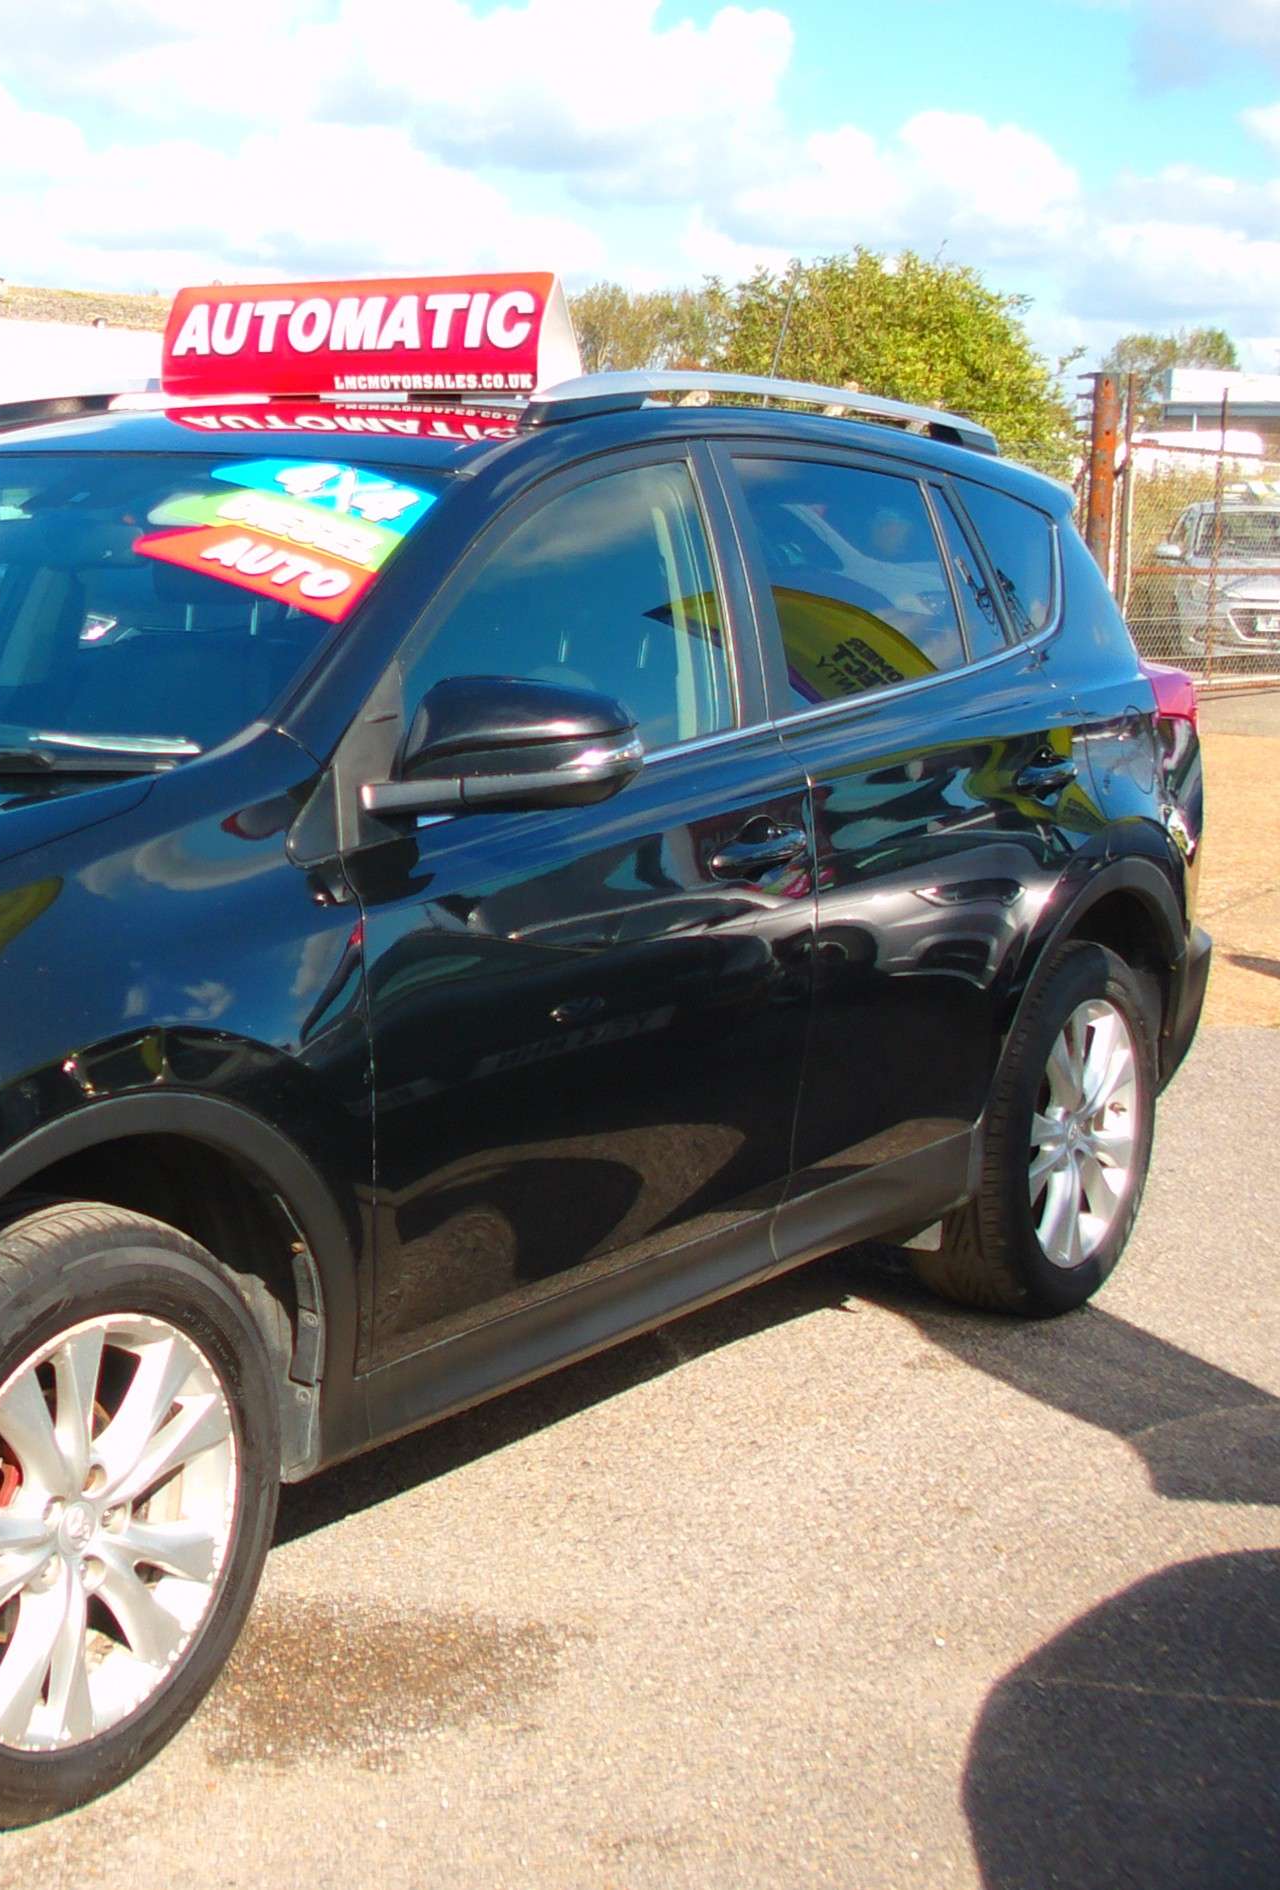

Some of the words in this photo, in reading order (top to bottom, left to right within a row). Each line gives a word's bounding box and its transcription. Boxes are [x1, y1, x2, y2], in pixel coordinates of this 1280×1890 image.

[171, 289, 536, 357] AUTOMATIC
[333, 373, 534, 391] LMCMOTORSALES.CO.UK
[199, 536, 353, 599] AUTO
